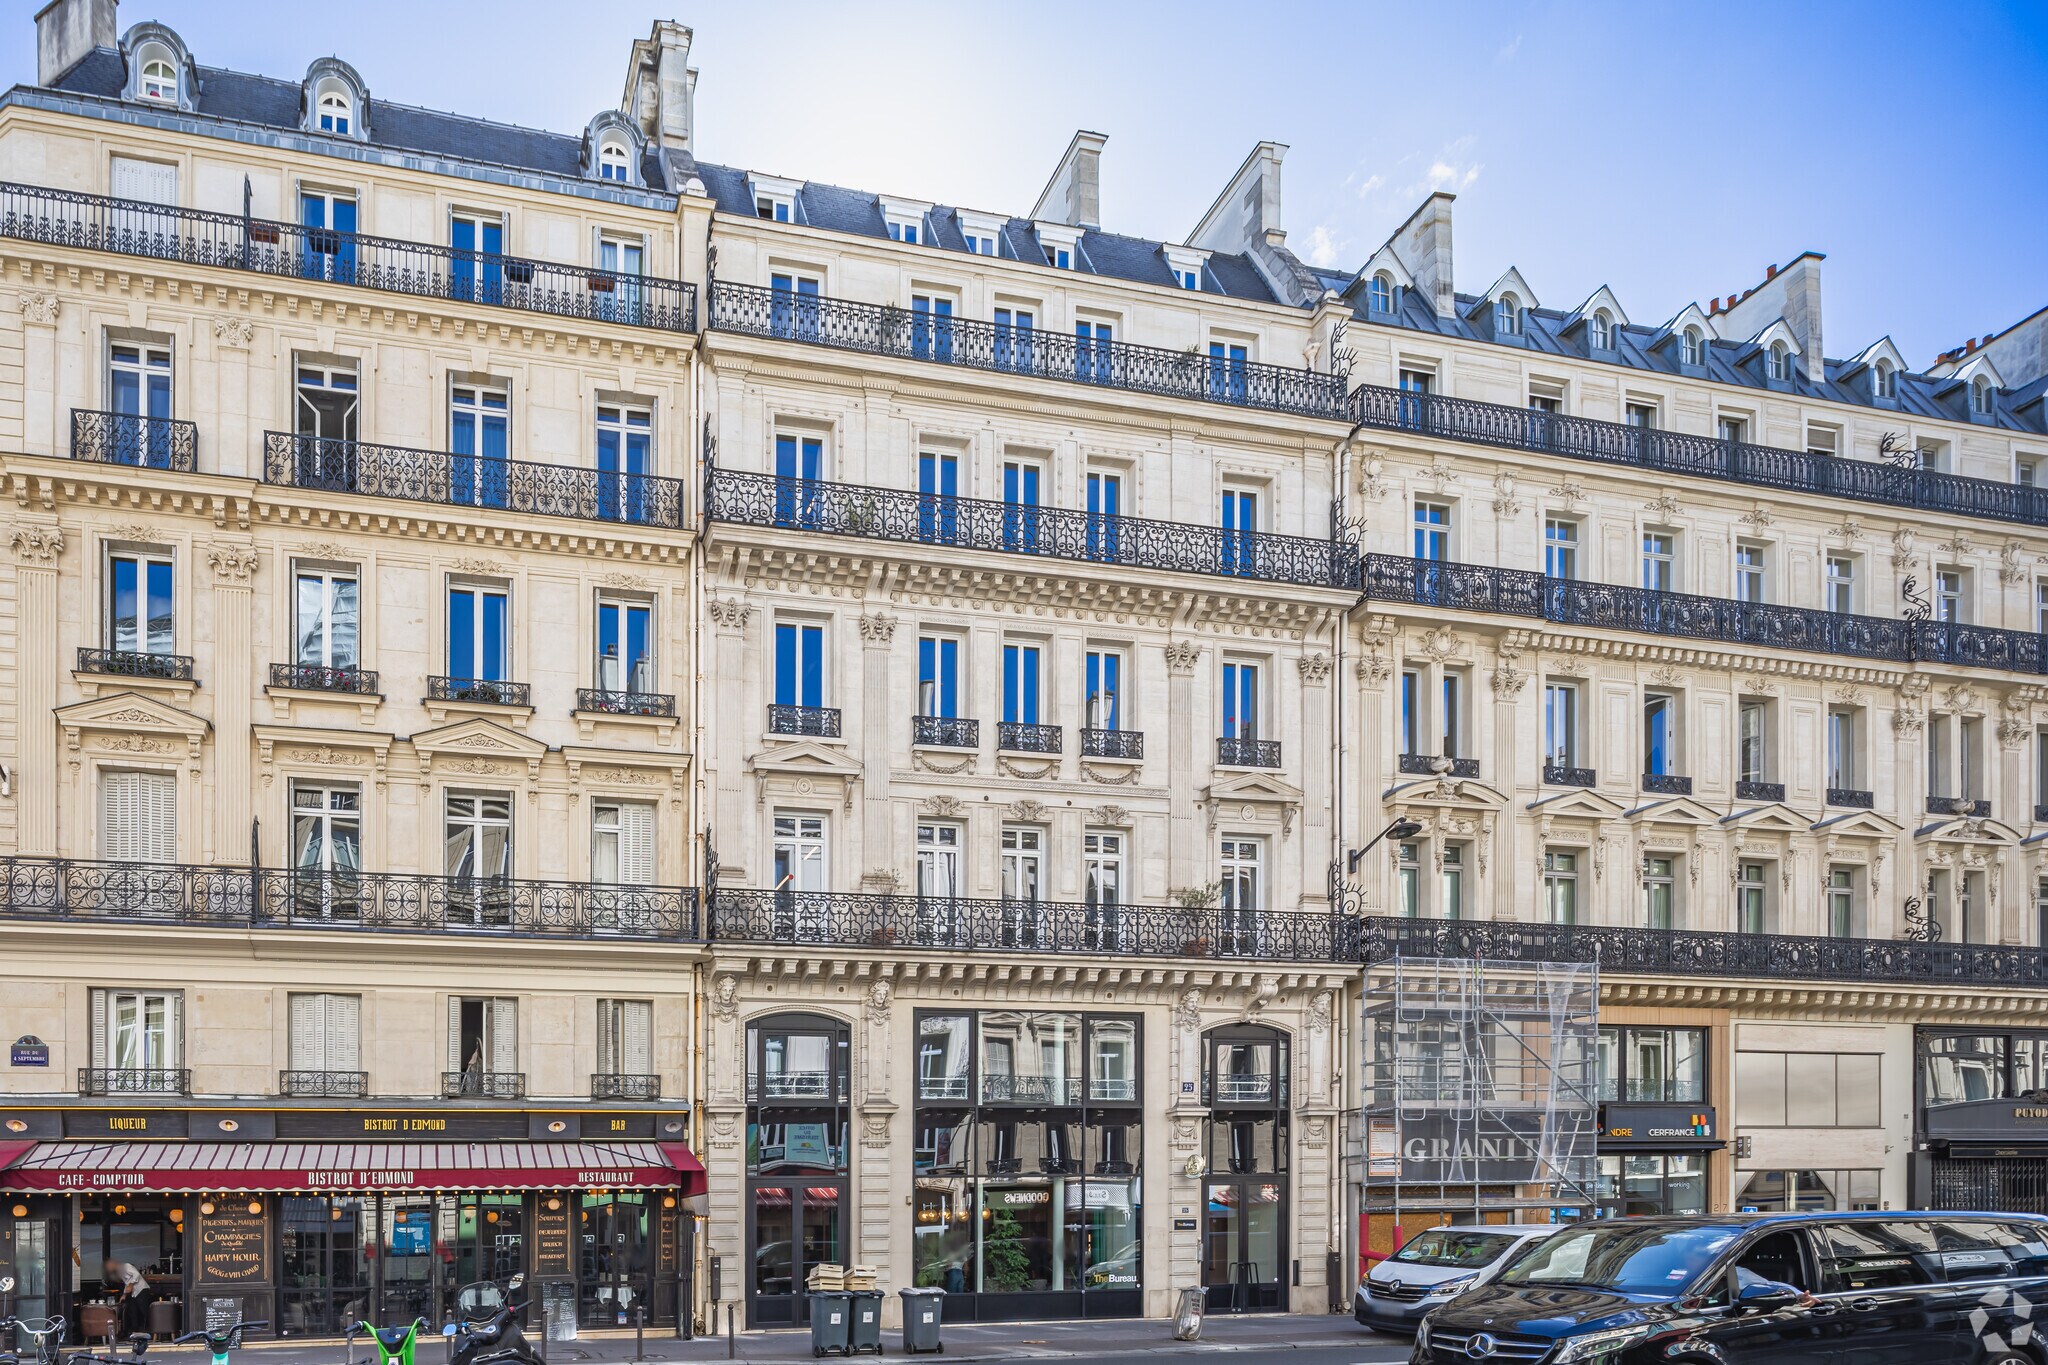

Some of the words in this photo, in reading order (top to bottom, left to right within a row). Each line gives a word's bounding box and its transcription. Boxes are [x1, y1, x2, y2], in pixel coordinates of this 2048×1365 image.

[1183, 1083, 1193, 1091] 25
[109, 1117, 147, 1131] LIQUEUR
[364, 1118, 398, 1131] BISTROT
[611, 1119, 626, 1131] BAR
[1605, 1128, 1633, 1137] NDRE
[1648, 1128, 1696, 1137] CERFRANCE
[1404, 1137, 1541, 1162] GRANIT
[93, 1173, 145, 1185] COMPTOIR
[308, 1171, 355, 1185] BISTROT
[360, 1170, 414, 1185] D'EDMOND
[578, 1171, 634, 1183] RESTAURANT
[1713, 1203, 1728, 1212] 27
[205, 1253, 231, 1262] HAPPY
